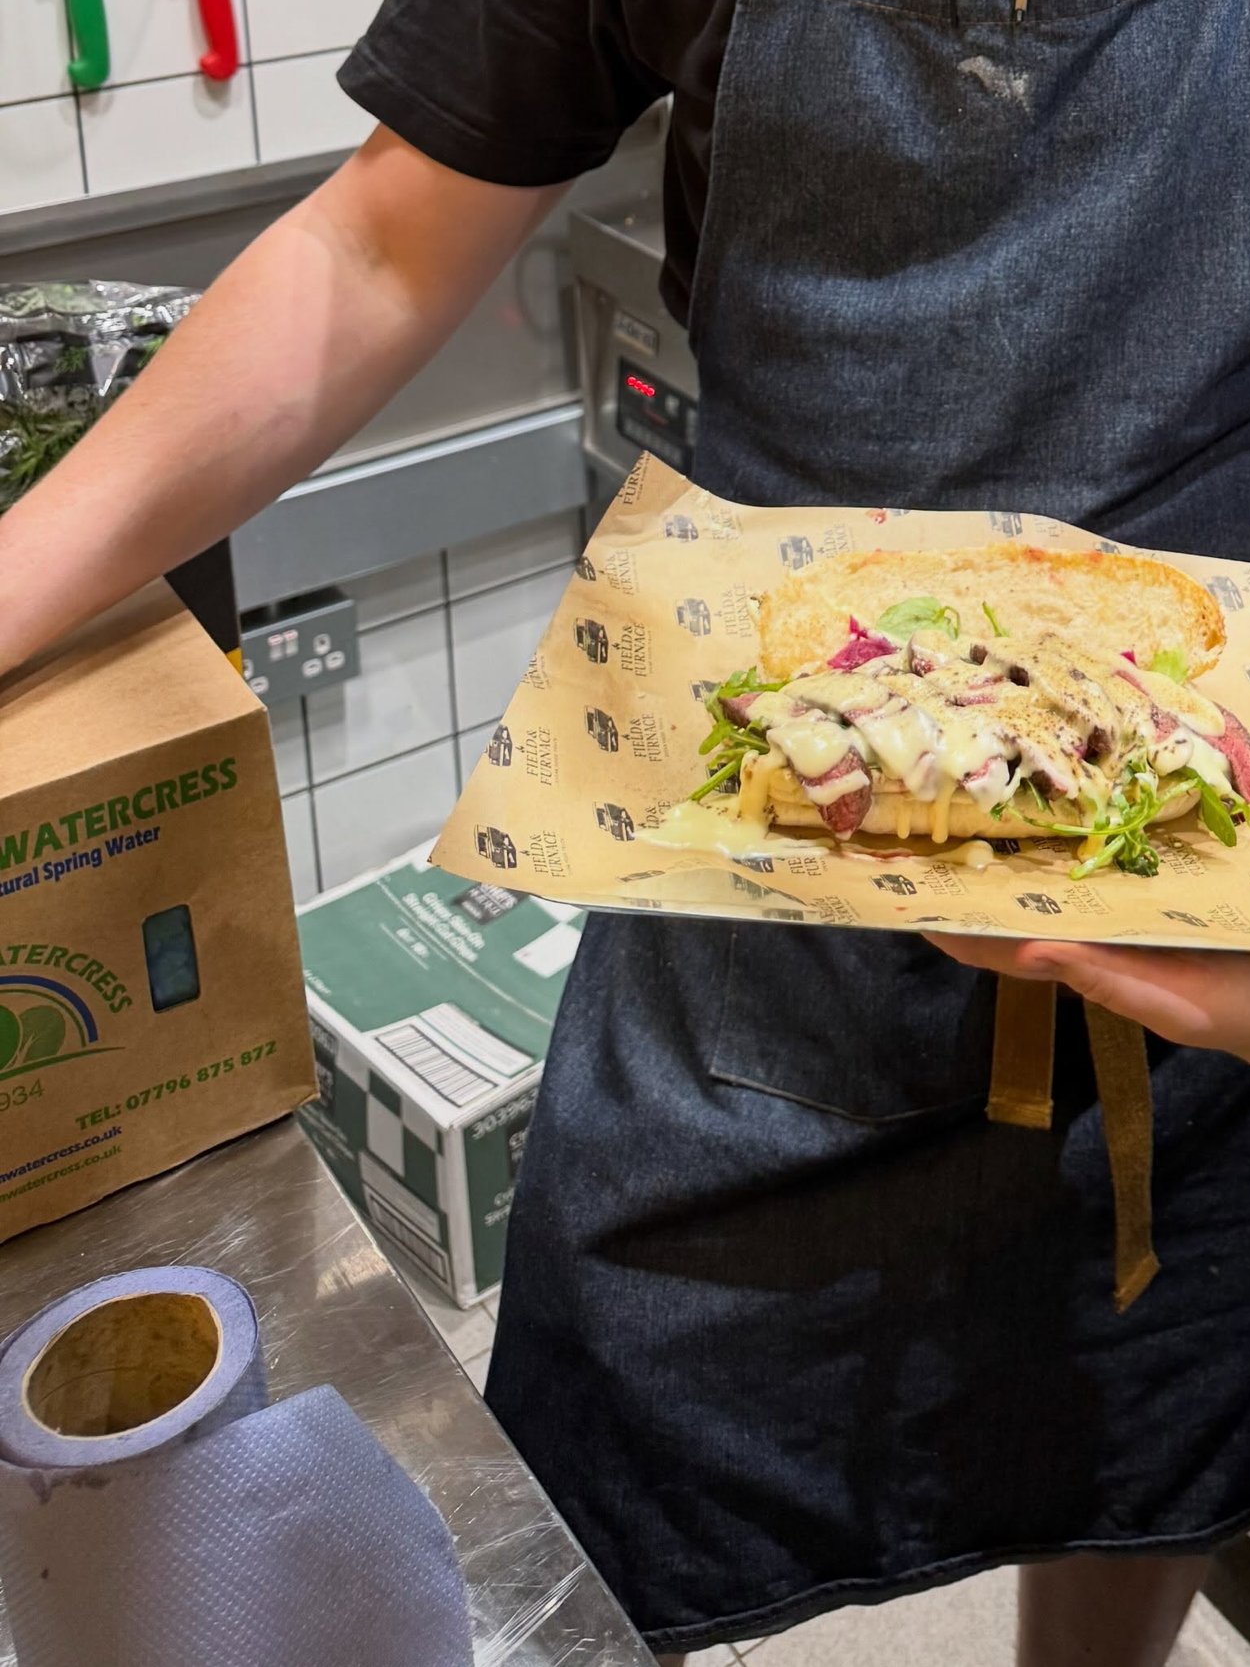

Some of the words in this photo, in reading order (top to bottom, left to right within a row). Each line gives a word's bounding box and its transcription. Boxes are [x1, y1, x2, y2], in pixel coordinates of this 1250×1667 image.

[617, 548, 635, 596] FURNACE
[734, 582, 753, 638] FURNACE
[634, 622, 648, 678] FURNACE
[539, 726, 552, 787] FURNACE
[642, 713, 663, 763] FURNACE
[0, 757, 238, 871] WATERCRESS
[43, 847, 102, 882] Spring
[105, 826, 161, 858] Water
[542, 829, 567, 879] FURNACE
[75, 1104, 122, 1131] TEL:
[125, 1074, 191, 1110] 07796
[196, 1057, 235, 1083] 875
[240, 1040, 277, 1067] 872
